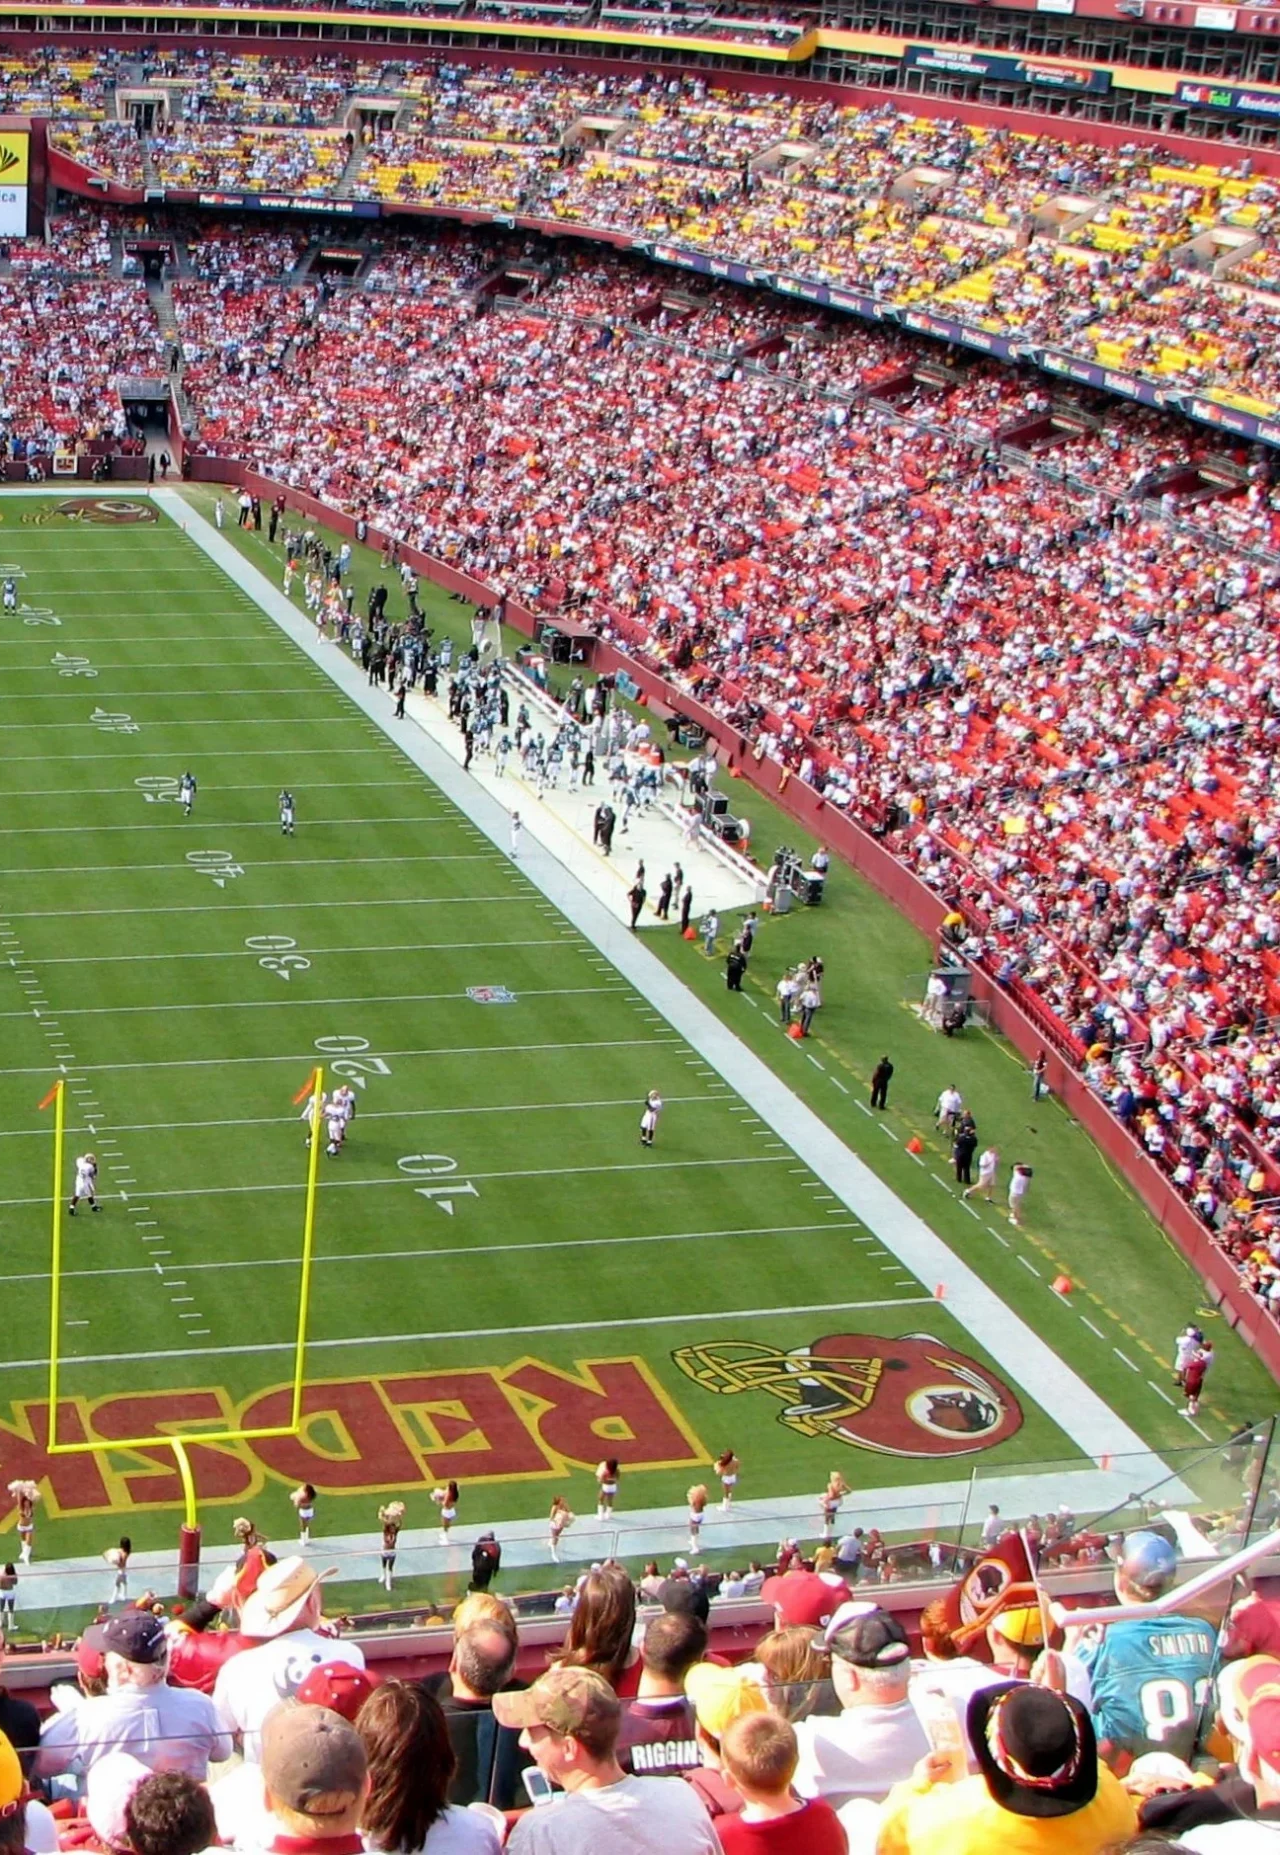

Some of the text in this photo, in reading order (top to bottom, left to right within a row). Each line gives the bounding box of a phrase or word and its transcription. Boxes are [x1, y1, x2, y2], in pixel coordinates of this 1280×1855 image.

[17, 608, 63, 626] 20
[51, 657, 98, 677] 30
[90, 713, 141, 734] 40
[134, 776, 184, 803] 50
[185, 850, 245, 878] 40
[245, 935, 311, 969] 30
[314, 1035, 392, 1075] 20
[397, 1154, 480, 1198] 10
[1148, 1634, 1209, 1657] SMITH
